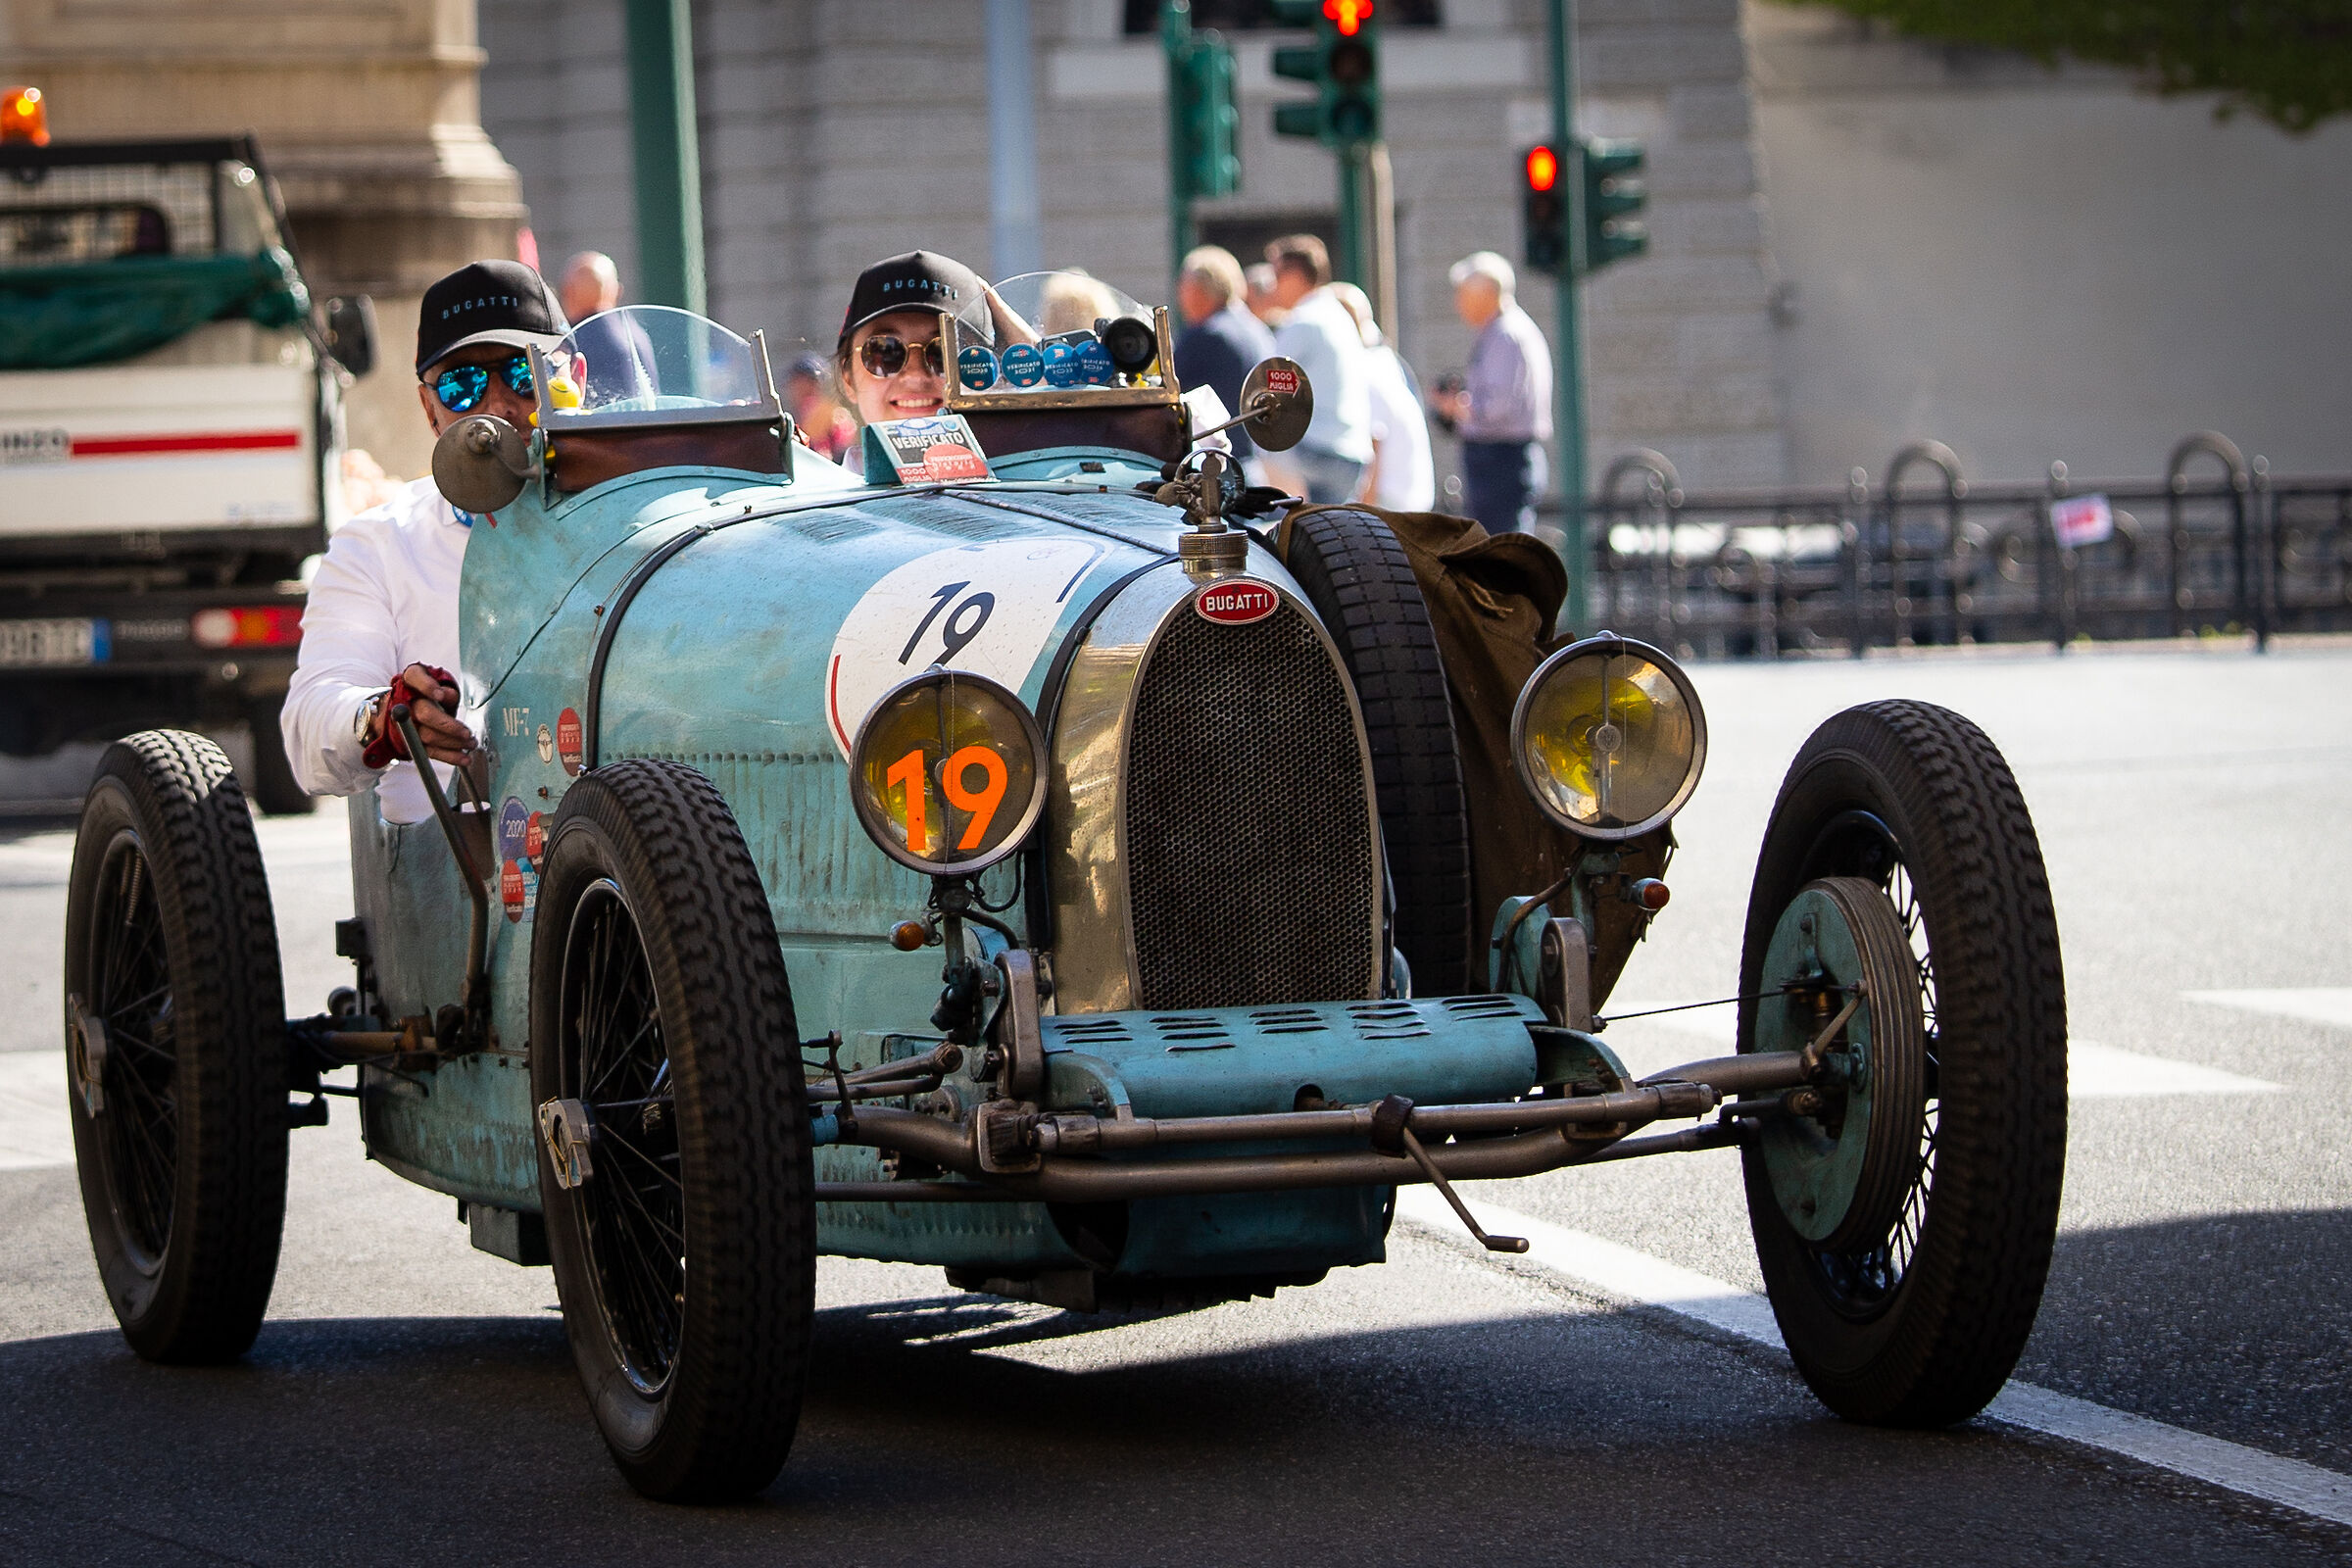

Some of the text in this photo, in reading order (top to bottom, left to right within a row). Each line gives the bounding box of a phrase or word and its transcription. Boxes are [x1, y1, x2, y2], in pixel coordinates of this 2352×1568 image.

[882, 278, 958, 300] BUGATTI
[441, 296, 519, 319] BUGATTI
[1270, 371, 1293, 380] 1000
[1269, 381, 1294, 391] MIGLIA
[892, 432, 964, 450] VERIFICATO
[1205, 593, 1268, 612] BUGATTI
[898, 580, 996, 673] 19
[887, 745, 1008, 852] 19
[506, 819, 526, 838] 2020
